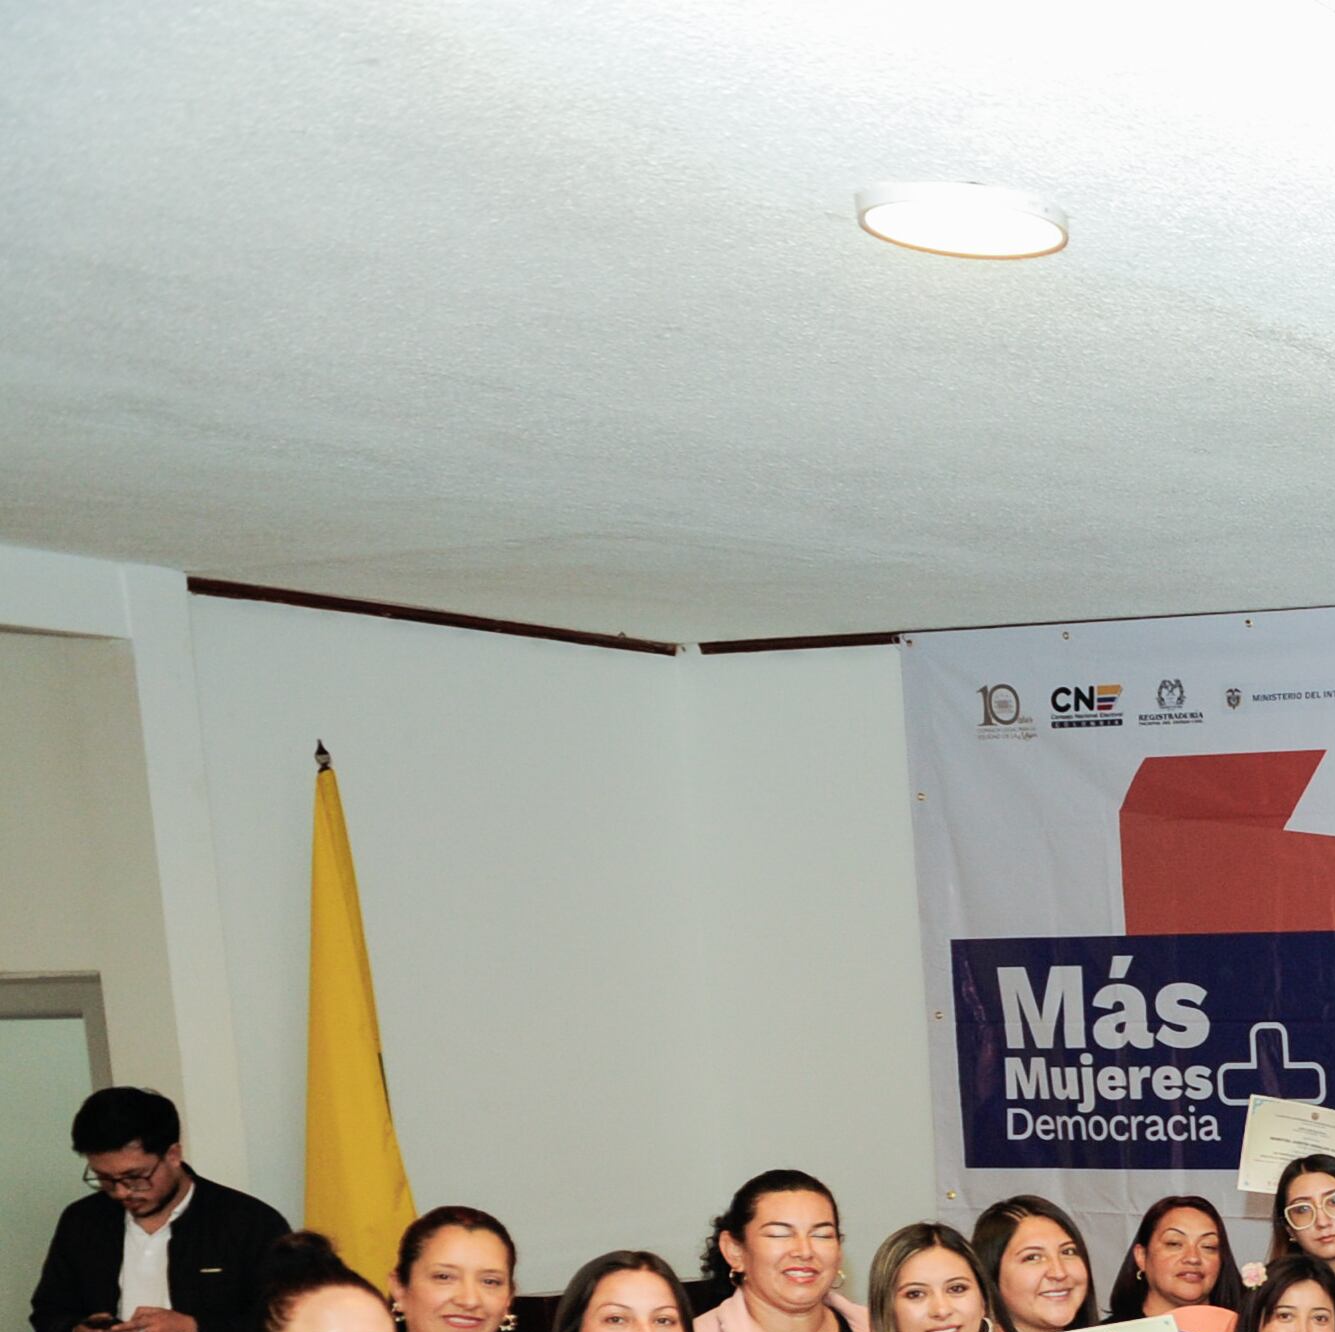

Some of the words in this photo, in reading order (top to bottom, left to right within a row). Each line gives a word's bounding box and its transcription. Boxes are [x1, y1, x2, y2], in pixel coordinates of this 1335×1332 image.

[1252, 692, 1303, 702] MINISTERIO
[1305, 691, 1321, 699] DEL
[997, 955, 1211, 1050] Más
[1004, 1053, 1214, 1113] Mujeres
[1006, 1106, 1221, 1142] Democracia
